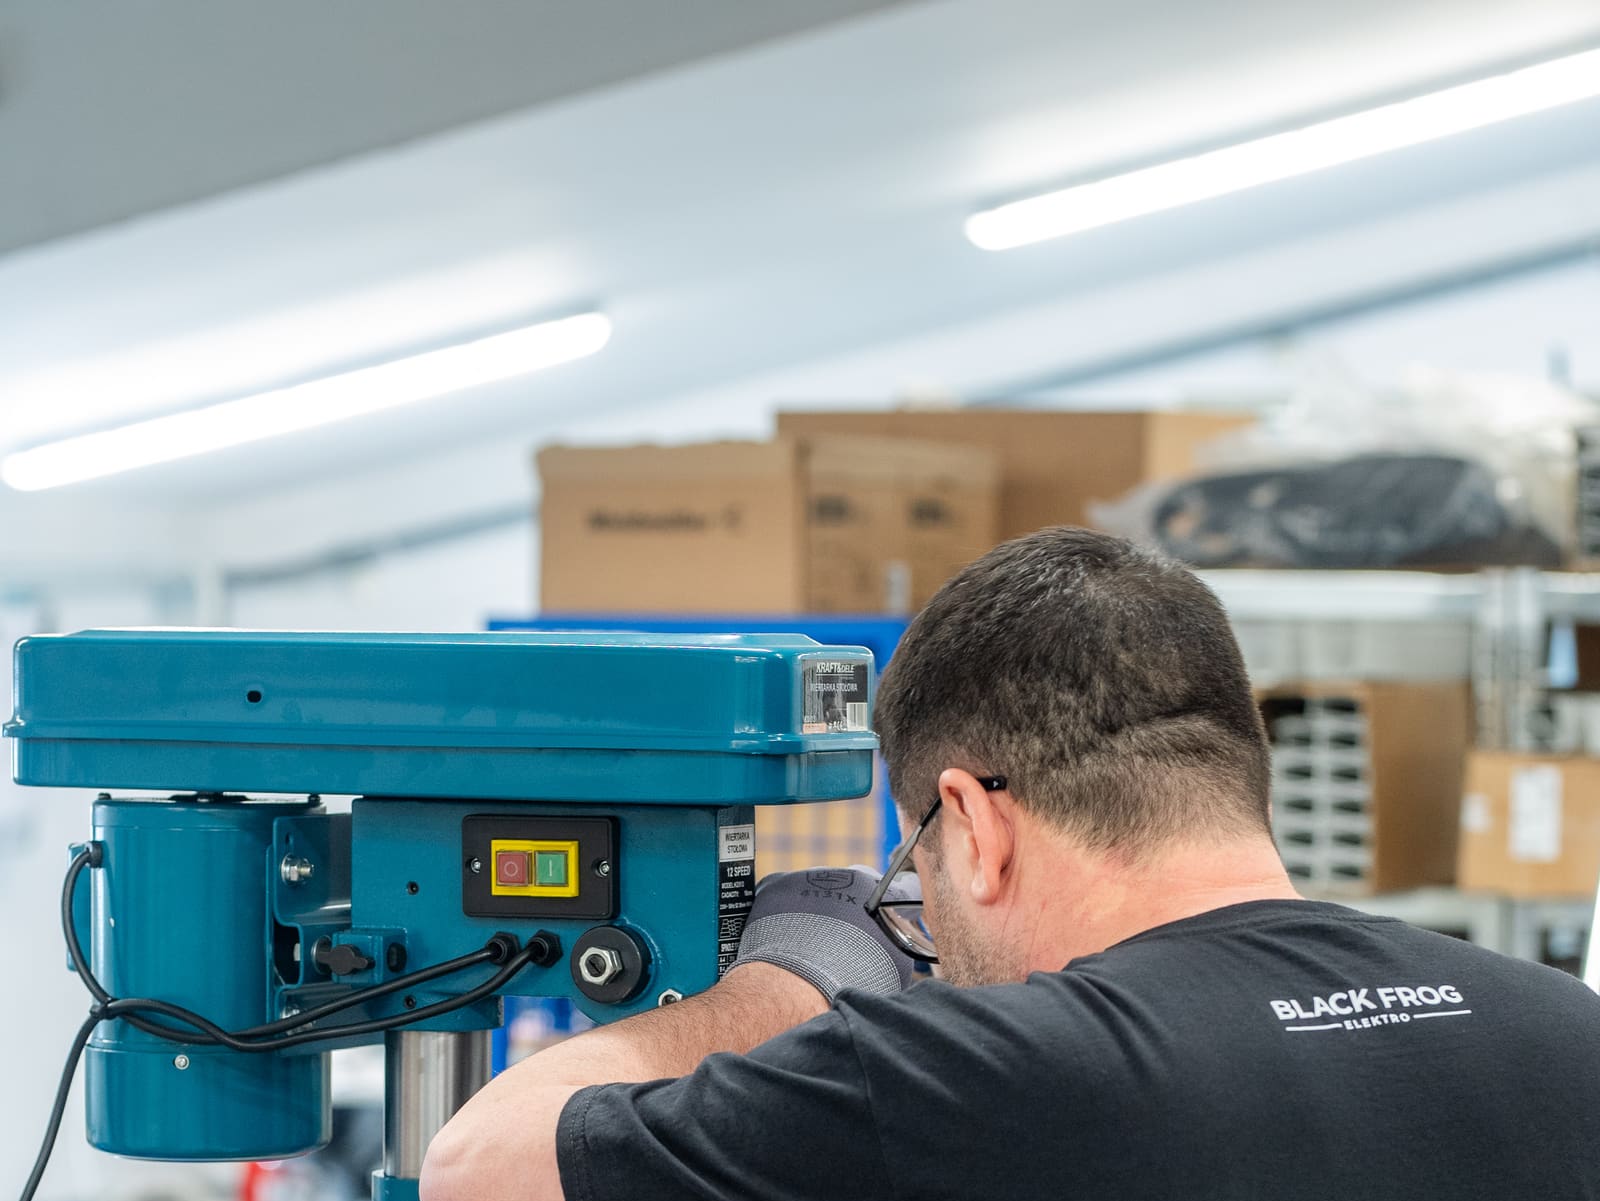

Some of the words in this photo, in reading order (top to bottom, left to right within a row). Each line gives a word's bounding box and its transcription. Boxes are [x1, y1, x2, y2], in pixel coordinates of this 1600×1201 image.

[816, 662, 855, 673] KRAFT&DELE
[727, 867, 734, 877] 12
[734, 865, 751, 877] SPEED
[1270, 988, 1377, 1020] BLACK
[1376, 984, 1464, 1009] FROG
[1343, 1012, 1411, 1030] ELEKTRO
